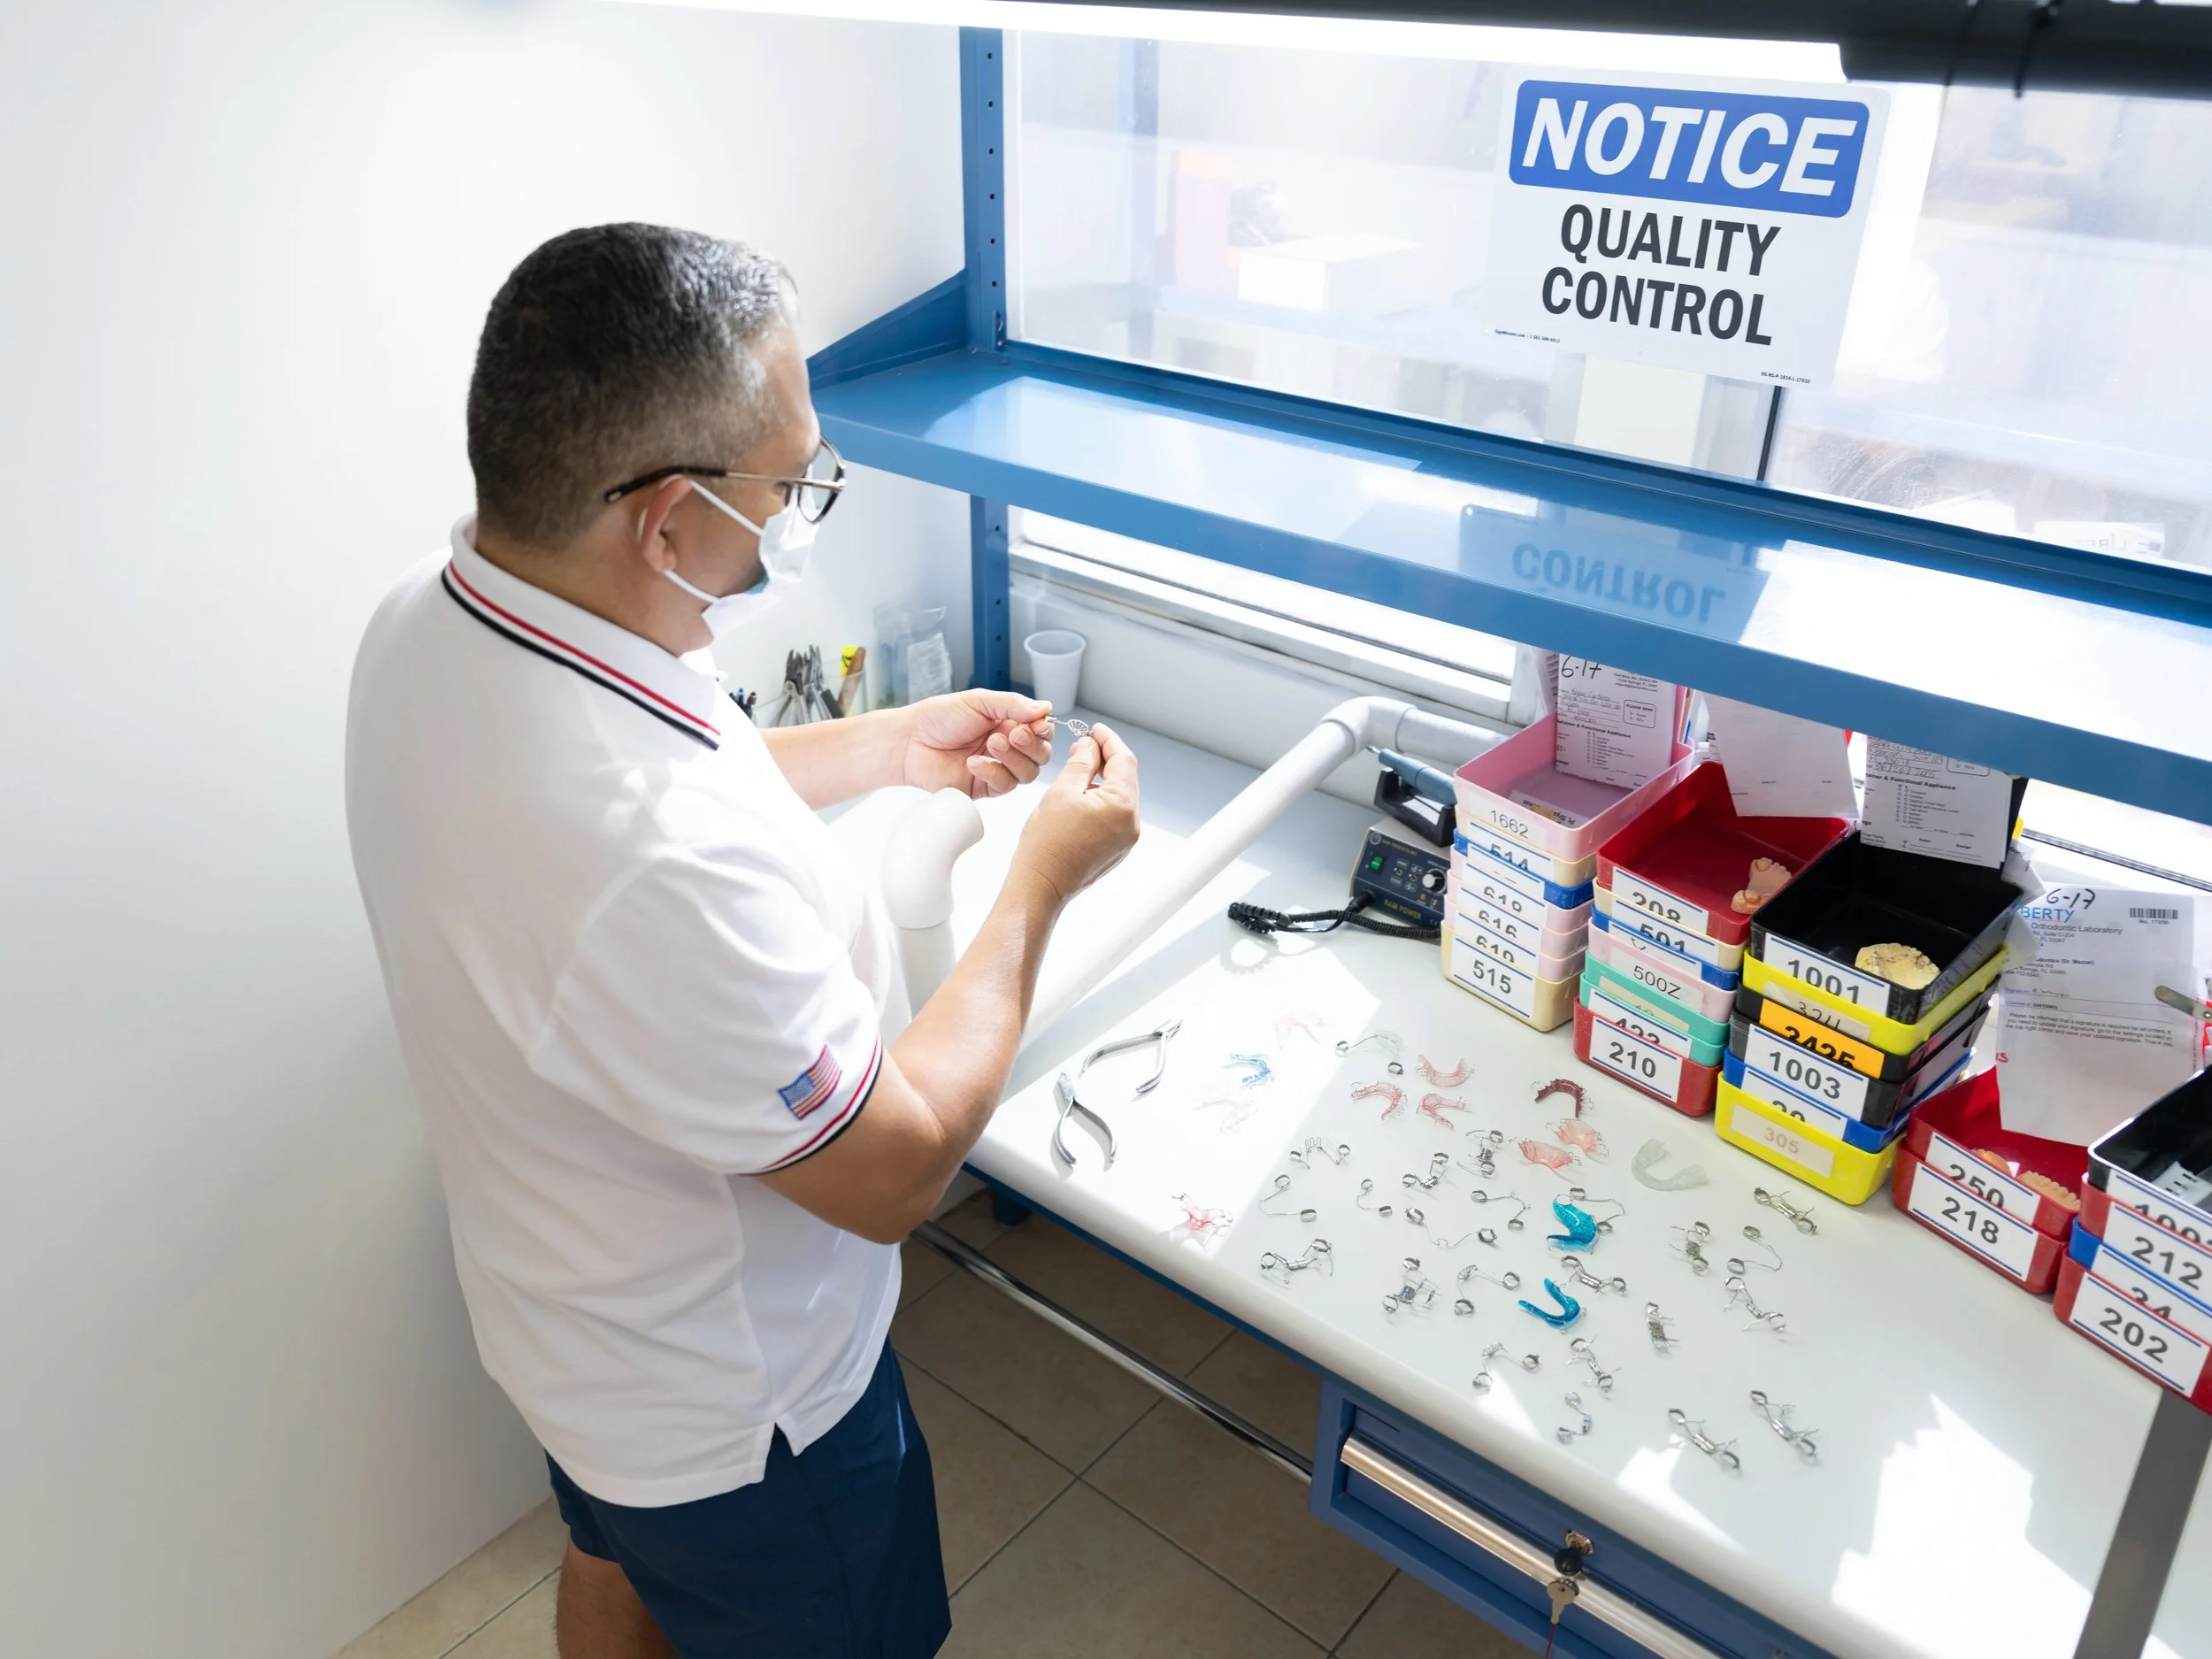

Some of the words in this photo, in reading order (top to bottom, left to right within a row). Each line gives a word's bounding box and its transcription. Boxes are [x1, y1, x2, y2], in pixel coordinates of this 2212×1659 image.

[1522, 97, 1857, 196] NOTICE
[1561, 204, 1781, 276] QUALITY
[1542, 266, 1772, 346] CONTROL
[1890, 776, 1924, 786] Functional
[1924, 781, 1956, 791] Appliance
[1490, 810, 1529, 840] 1662
[1632, 891, 1681, 924] 208
[2020, 907, 2075, 924] BERTY
[1640, 923, 1686, 952] 501
[2031, 922, 2077, 933] Orthodontic
[2078, 925, 2124, 935] Laboratory
[1472, 959, 1511, 995] 515
[1787, 959, 1860, 1005] 1001
[1609, 1041, 1656, 1079] 210
[1770, 1051, 1840, 1100] 1003
[1765, 1126, 1800, 1154] 305
[1949, 1164, 2004, 1209] 250
[1940, 1196, 1999, 1244] 218
[2131, 1236, 2202, 1291] 212
[2099, 1307, 2169, 1363] 202
